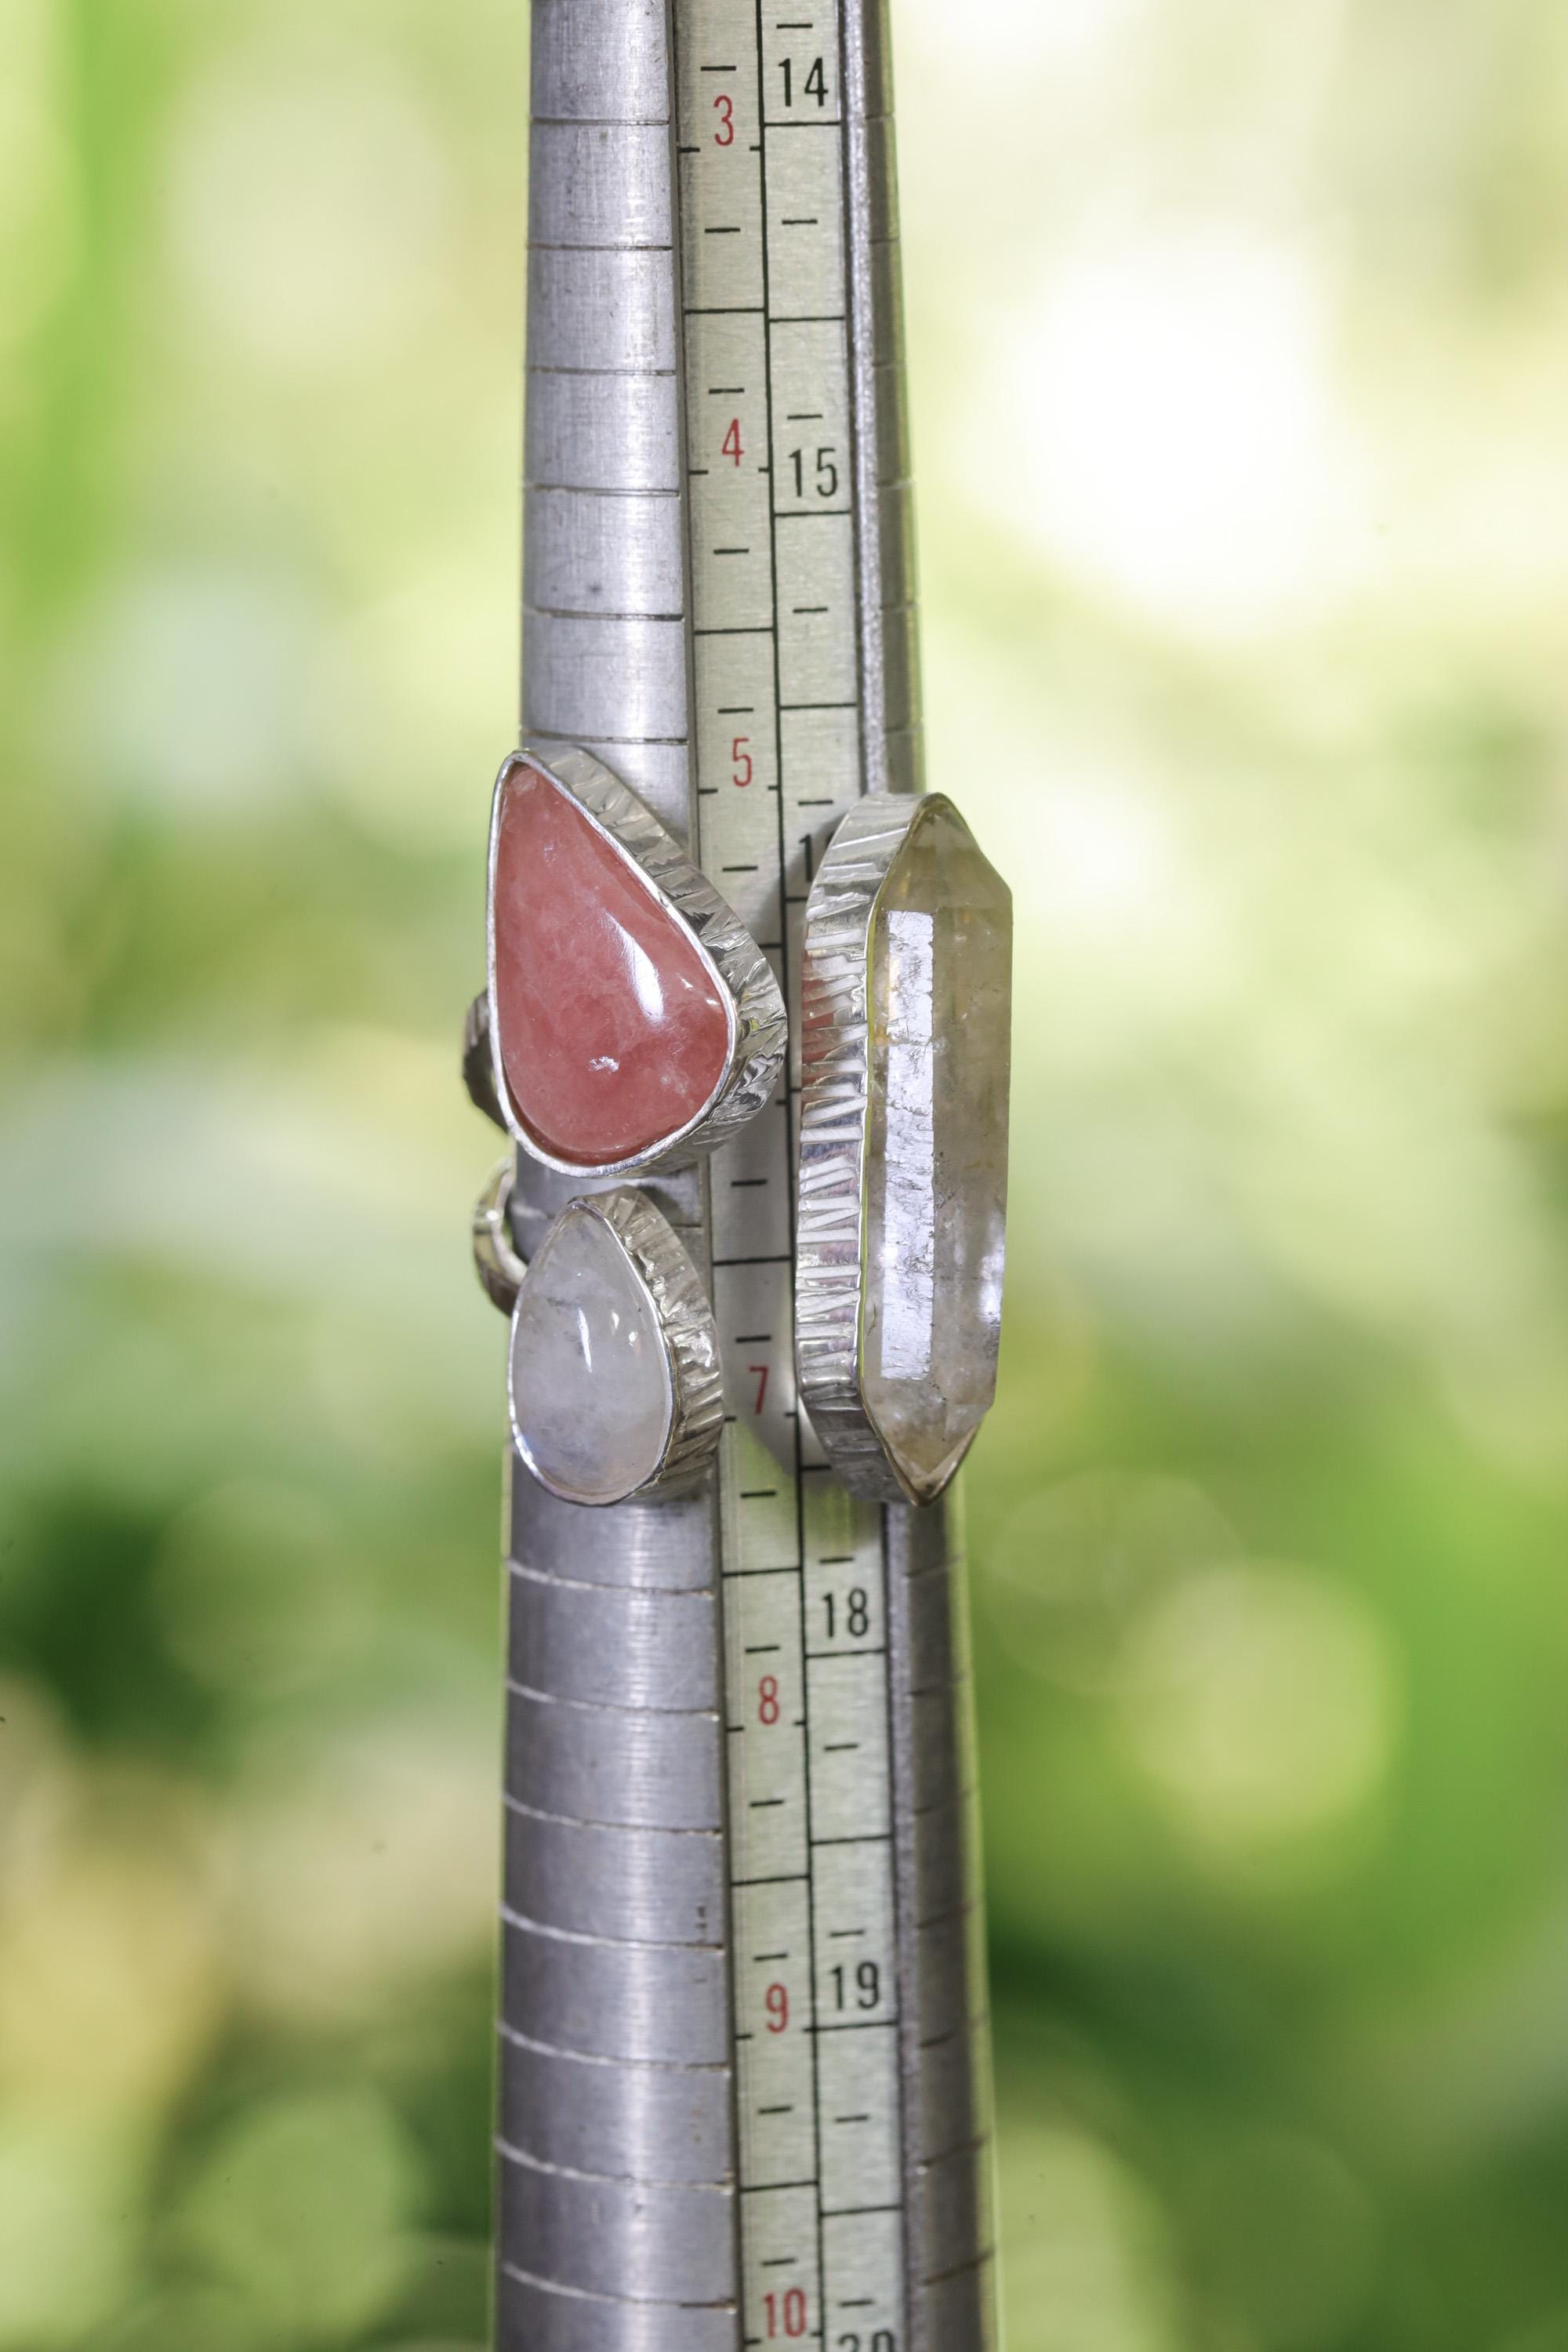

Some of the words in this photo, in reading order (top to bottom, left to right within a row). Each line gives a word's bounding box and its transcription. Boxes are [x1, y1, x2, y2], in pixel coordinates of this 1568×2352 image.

[777, 56, 829, 108] 14
[714, 95, 735, 146] 3
[721, 419, 745, 467] 4
[789, 448, 837, 497] 15
[732, 738, 753, 788] 5
[750, 1366, 769, 1414] 7
[822, 1588, 869, 1639] 18
[758, 1675, 779, 1726] 8
[766, 1983, 788, 2034] 9
[831, 1961, 880, 2011] 19
[762, 2287, 807, 2339] 10
